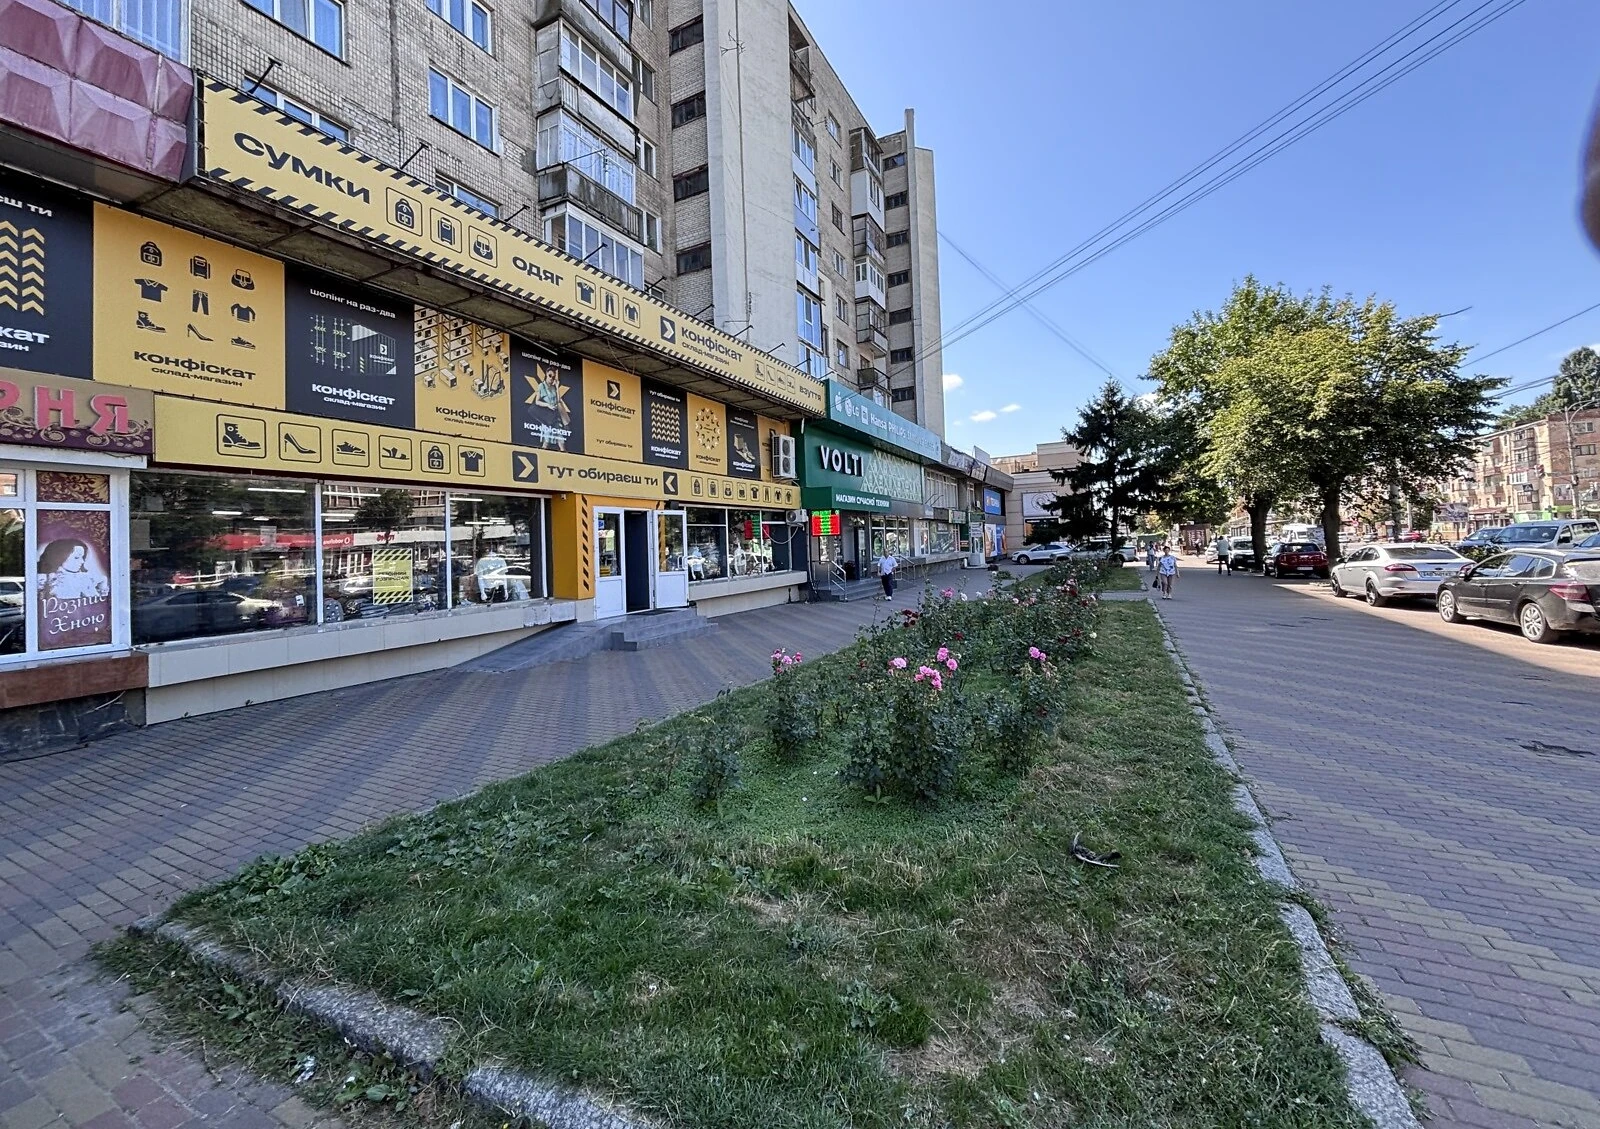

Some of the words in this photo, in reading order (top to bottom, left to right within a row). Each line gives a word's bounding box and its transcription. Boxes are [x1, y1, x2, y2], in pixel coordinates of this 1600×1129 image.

[234, 132, 370, 205] сумки
[26, 203, 53, 217] ти
[512, 256, 564, 287] одяг
[310, 288, 346, 304] шопінг
[346, 299, 359, 308] на
[359, 303, 396, 319] раз-два
[681, 327, 743, 363] конфіскат
[681, 341, 730, 366] склад-магазин
[134, 350, 256, 380] конфіскат
[151, 367, 243, 387] склад-магазин
[311, 383, 396, 405] конфіскат
[323, 396, 386, 411] склад-магазин
[799, 385, 822, 402] взуття
[435, 406, 496, 423] конфіскат
[590, 398, 636, 415] конфіскат
[870, 413, 887, 430] Hansa
[820, 444, 864, 477] VOLTI
[547, 465, 575, 479] тут
[577, 467, 642, 484] обираєш
[644, 476, 659, 486] ти
[49, 613, 105, 635] Хною
